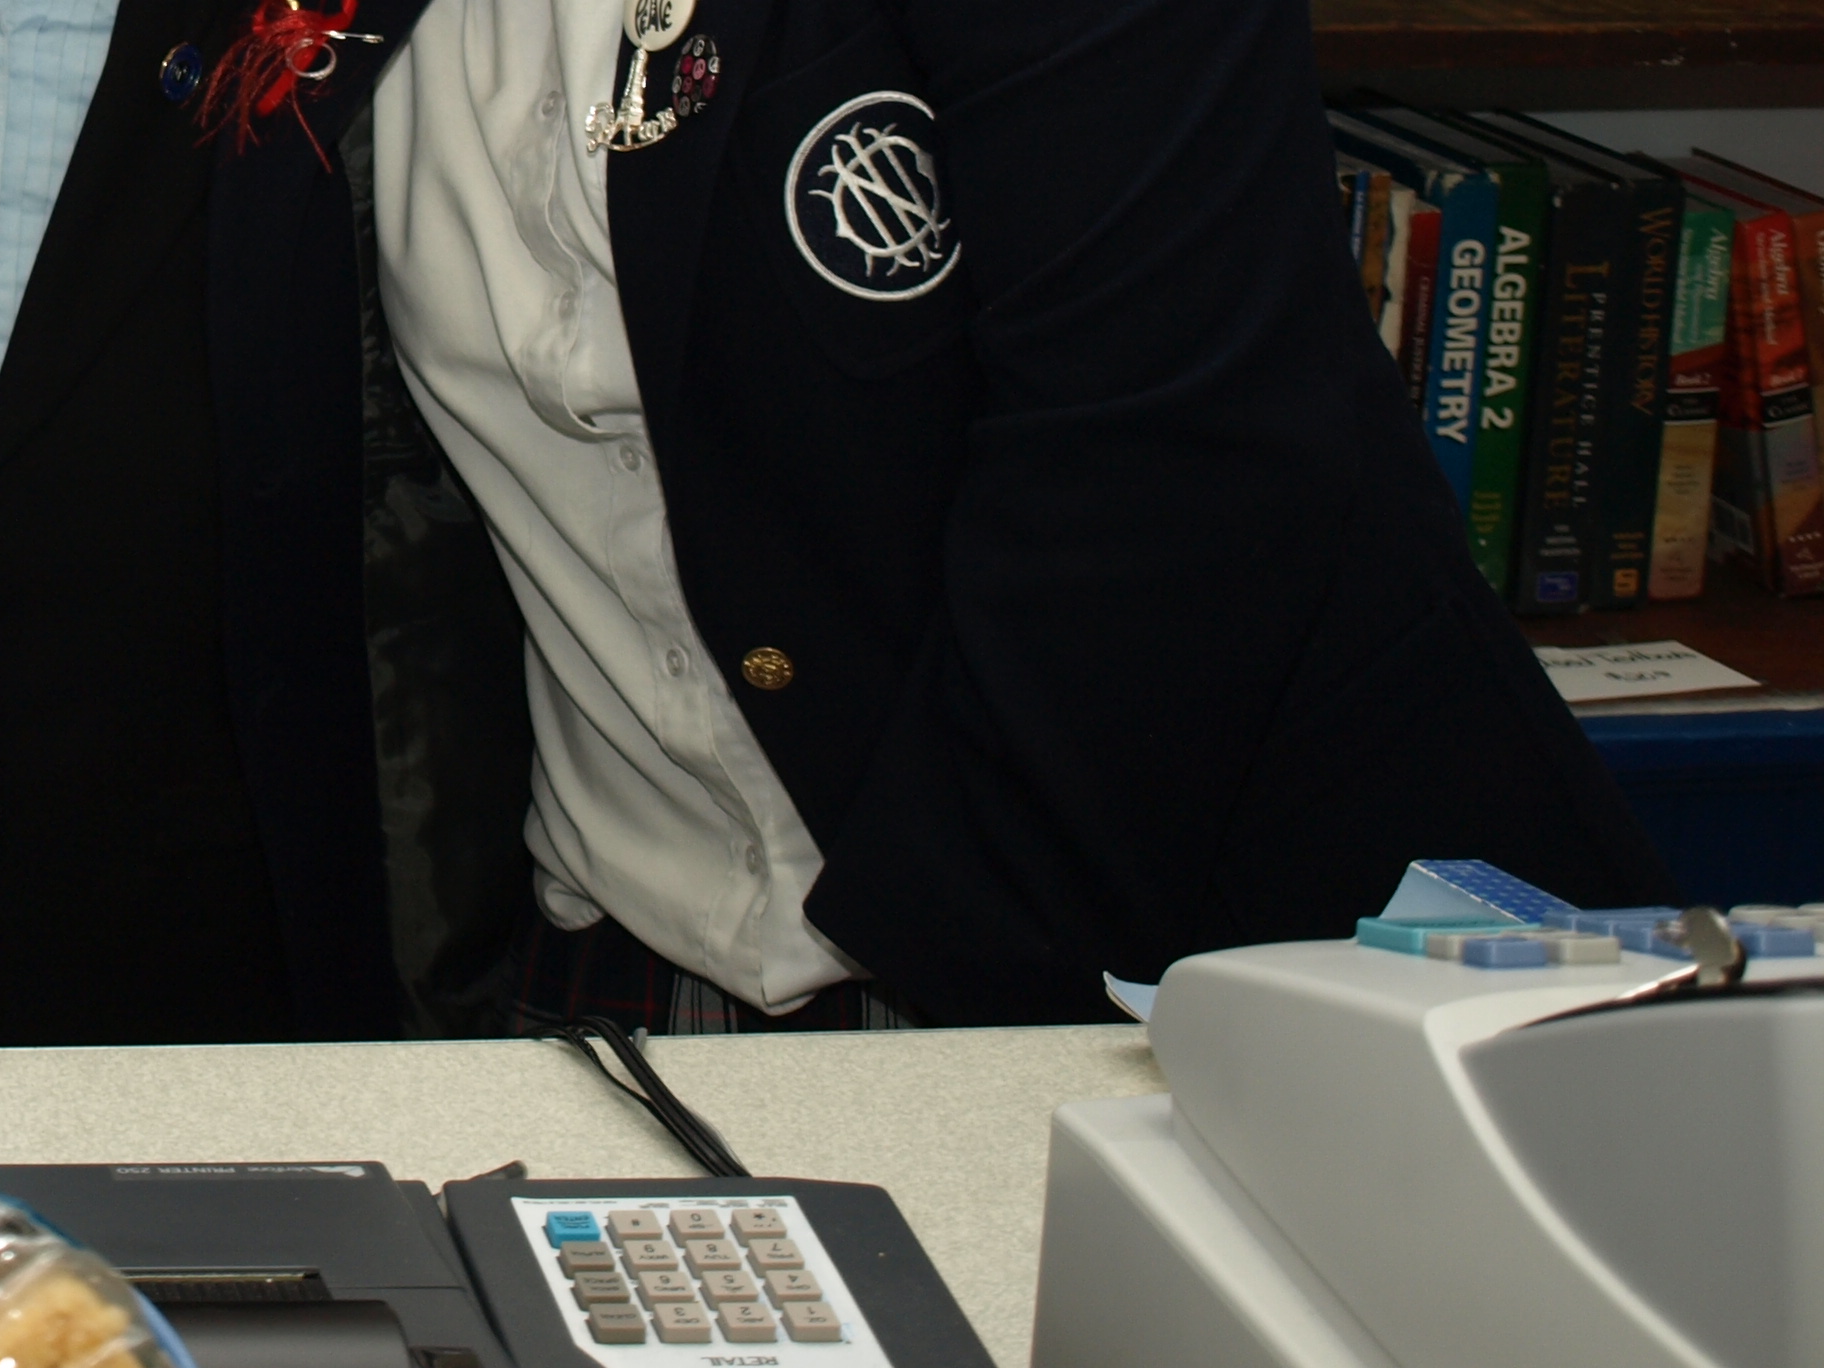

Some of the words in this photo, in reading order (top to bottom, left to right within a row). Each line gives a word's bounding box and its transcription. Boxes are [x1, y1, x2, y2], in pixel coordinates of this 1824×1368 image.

[1637, 207, 1673, 310] WORLD
[1769, 229, 1790, 295] Algebra
[1706, 228, 1729, 301] Algebra
[1483, 226, 1532, 397] ALGEBRA
[1435, 238, 1487, 445] GEOMETRY
[1578, 291, 1608, 426] PRENTICE
[1630, 315, 1663, 415] HISTORY
[1542, 261, 1611, 510] LITERATURE
[1480, 405, 1514, 430] 2
[1572, 440, 1593, 508] HALL
[116, 1166, 151, 1175] 250
[158, 1166, 236, 1174] PRINTER
[691, 1213, 701, 1223] 0
[643, 1243, 655, 1254] 9
[706, 1243, 718, 1254] 8
[771, 1243, 782, 1253] 7
[659, 1274, 671, 1284] 6
[723, 1274, 735, 1284] 5
[788, 1274, 799, 1284] 4
[674, 1307, 686, 1317] 3
[740, 1306, 751, 1317] 2
[807, 1306, 815, 1316] 1
[701, 1356, 779, 1367] RETAIL
